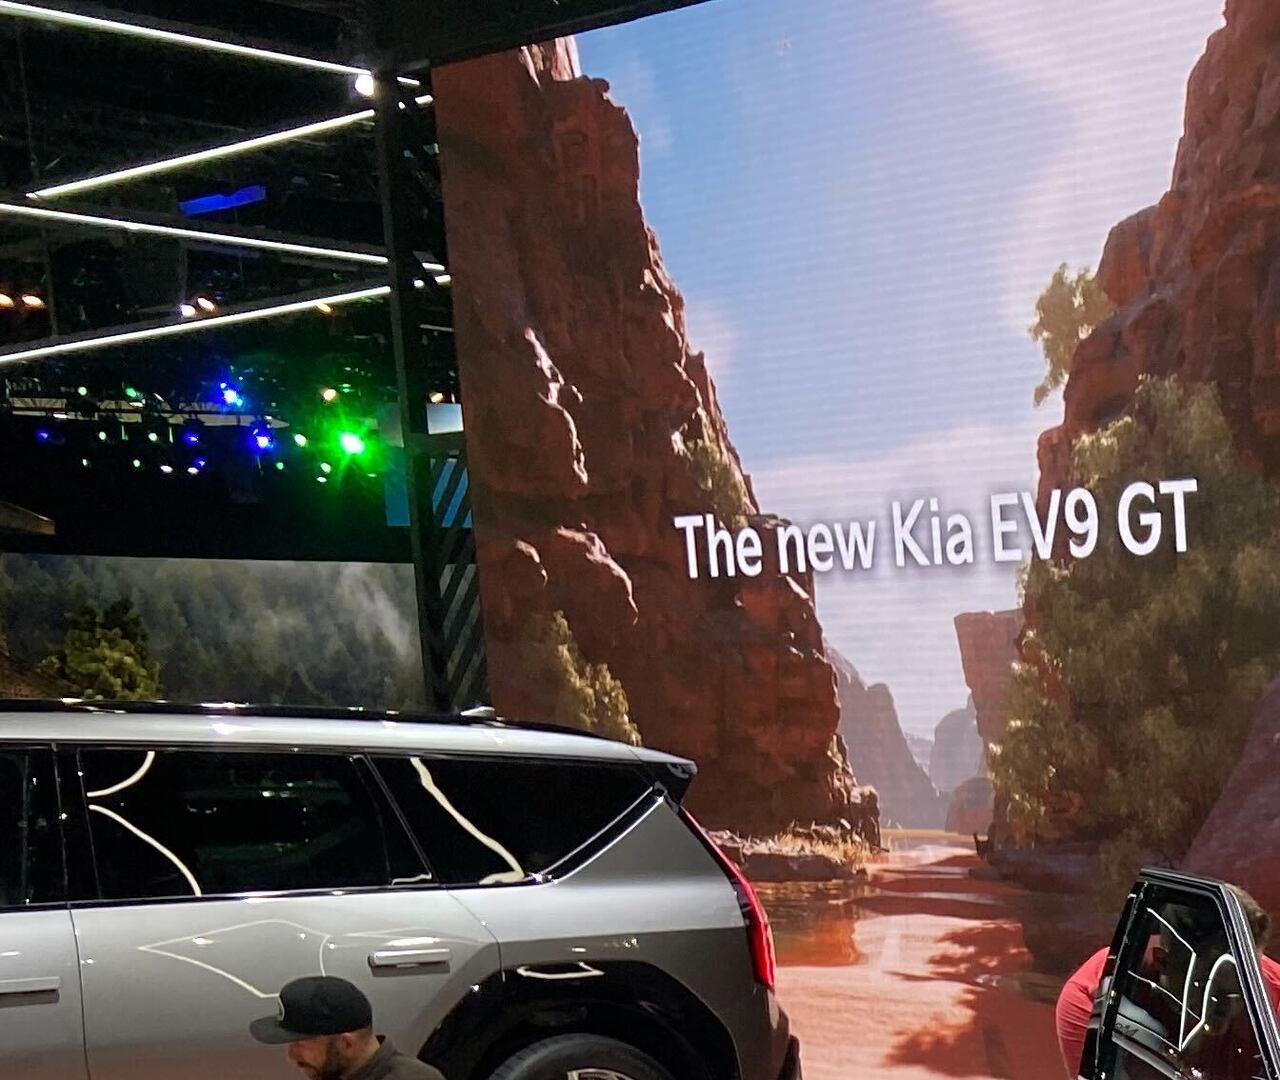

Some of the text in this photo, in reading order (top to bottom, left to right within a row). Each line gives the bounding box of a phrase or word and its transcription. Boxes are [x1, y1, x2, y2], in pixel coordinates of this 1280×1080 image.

[673, 478, 1198, 579] The new Kia EV9 GT
